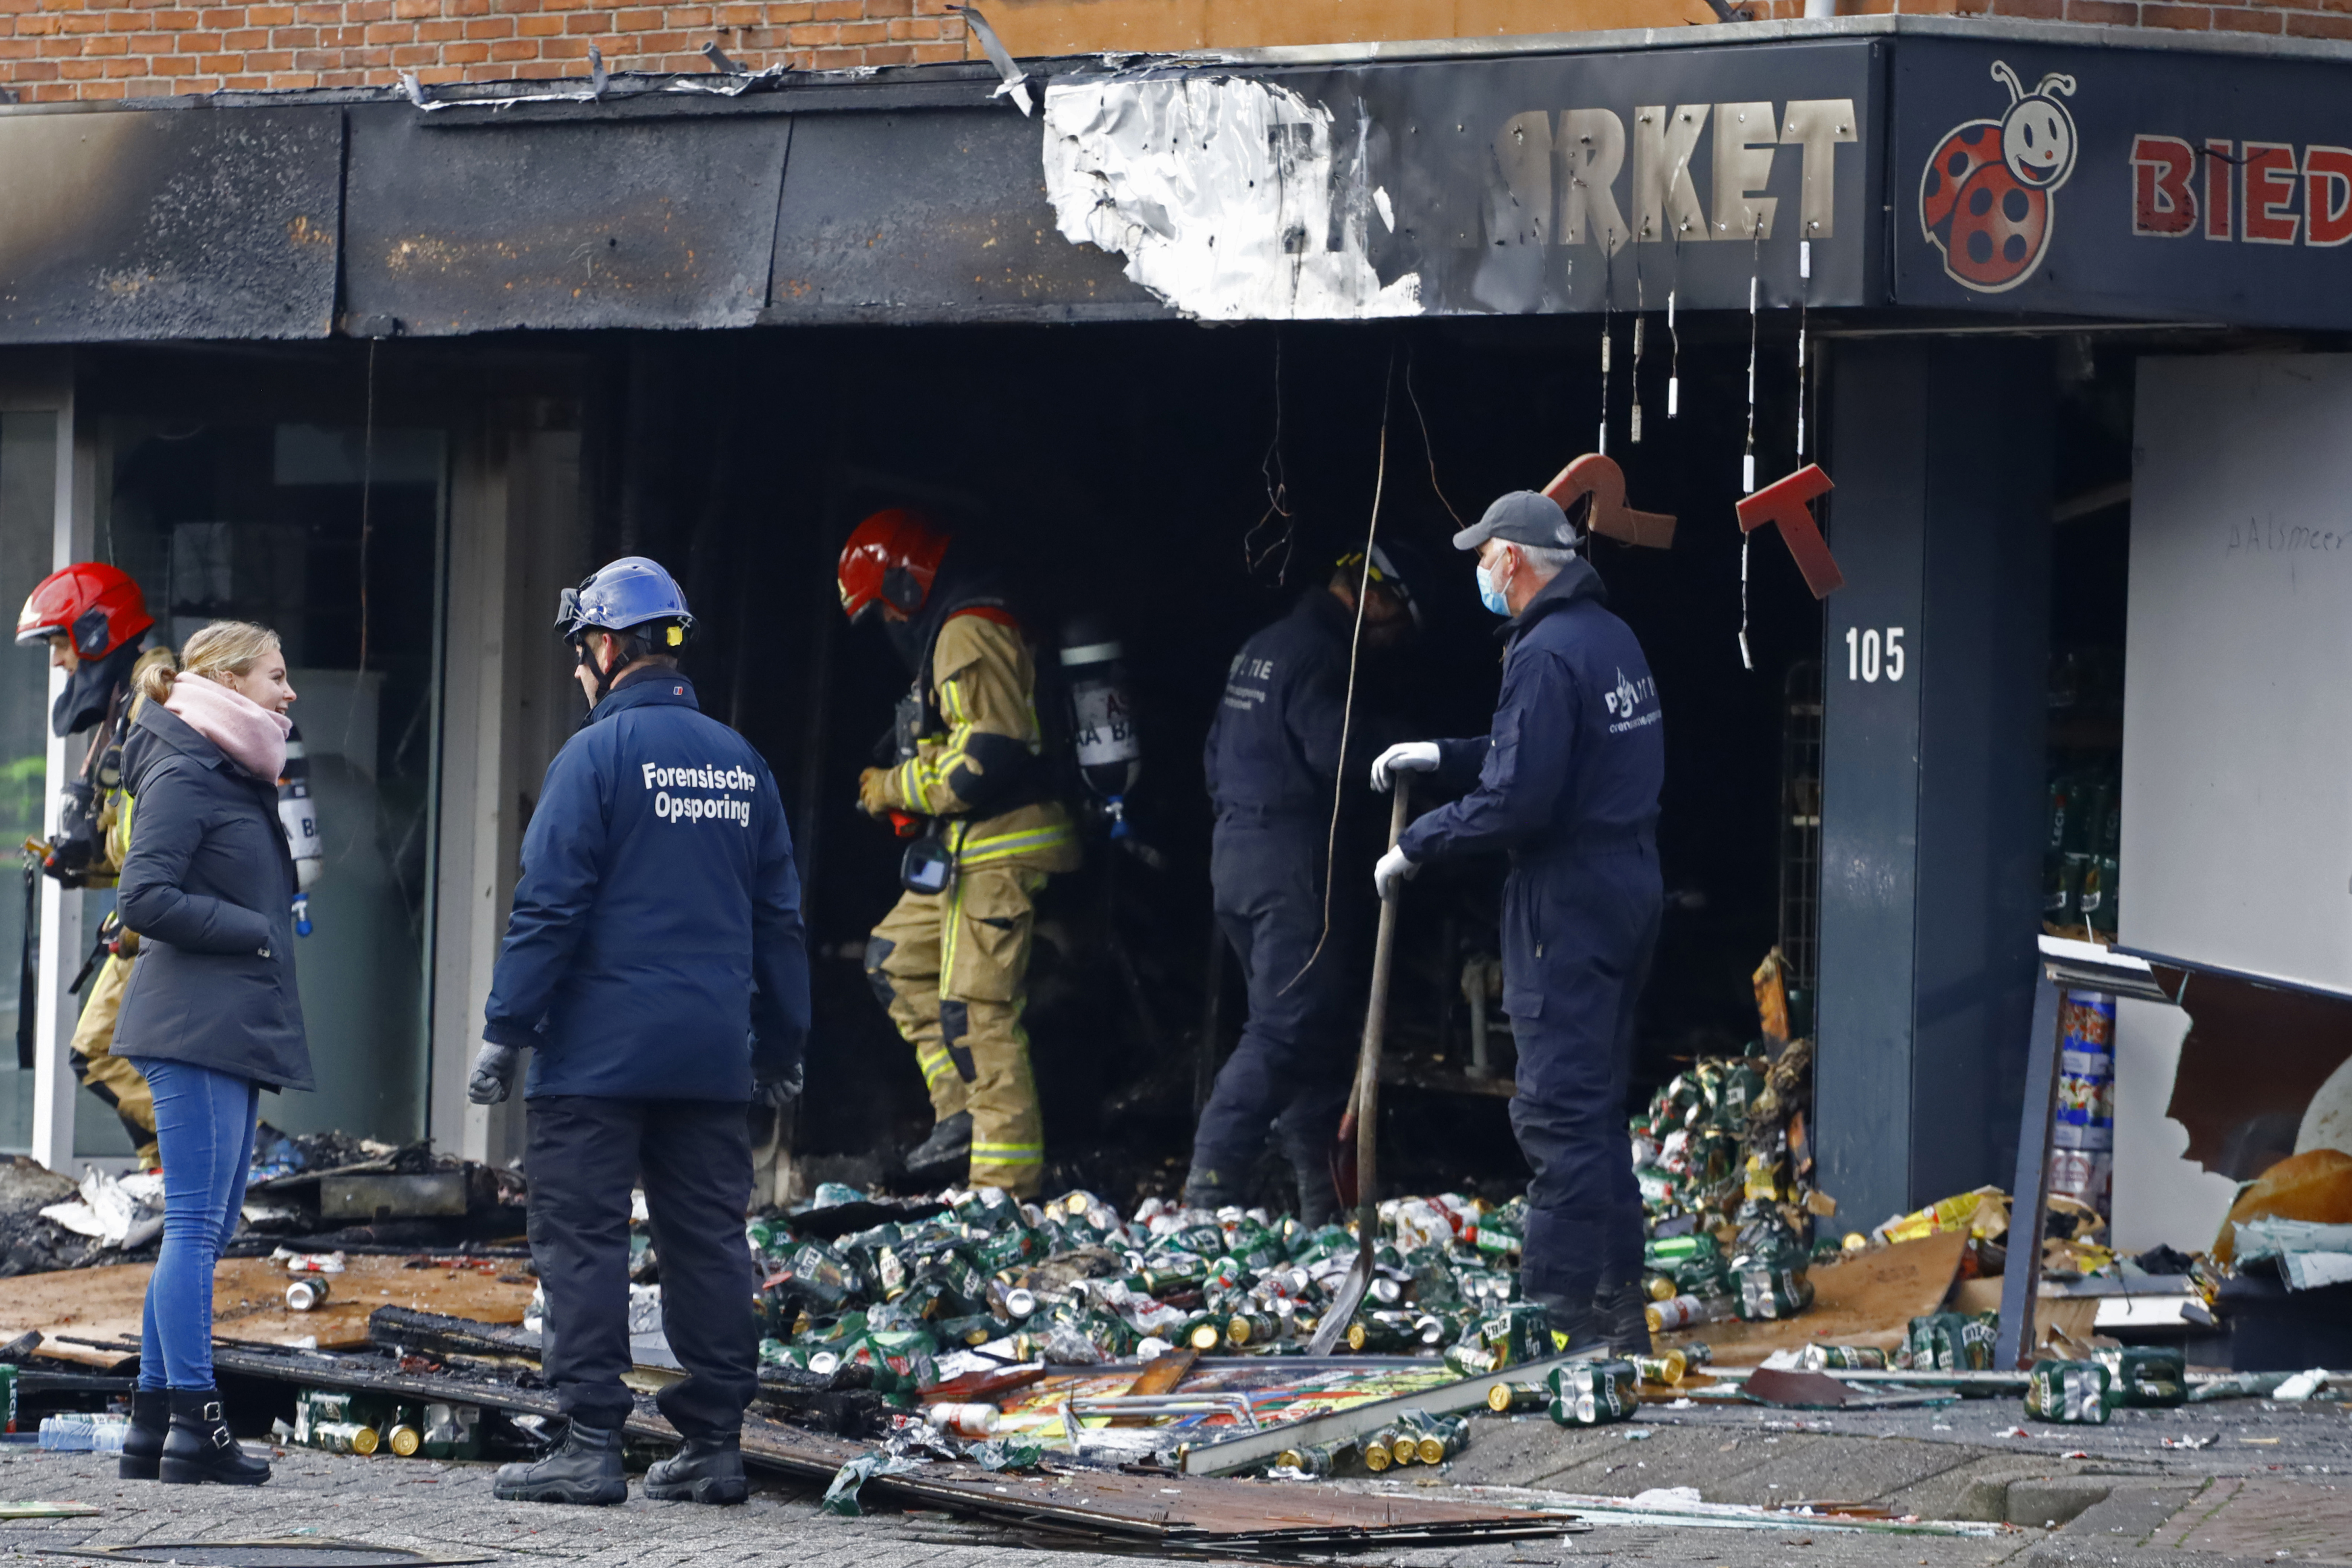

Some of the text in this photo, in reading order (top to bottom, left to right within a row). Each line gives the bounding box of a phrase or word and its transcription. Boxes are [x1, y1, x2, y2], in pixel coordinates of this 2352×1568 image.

[2129, 133, 2352, 247] BIED
[1846, 627, 1904, 683] 105
[642, 762, 755, 792] Forensische
[655, 792, 750, 827] Opsporing
[9, 1379, 18, 1422] LECH
